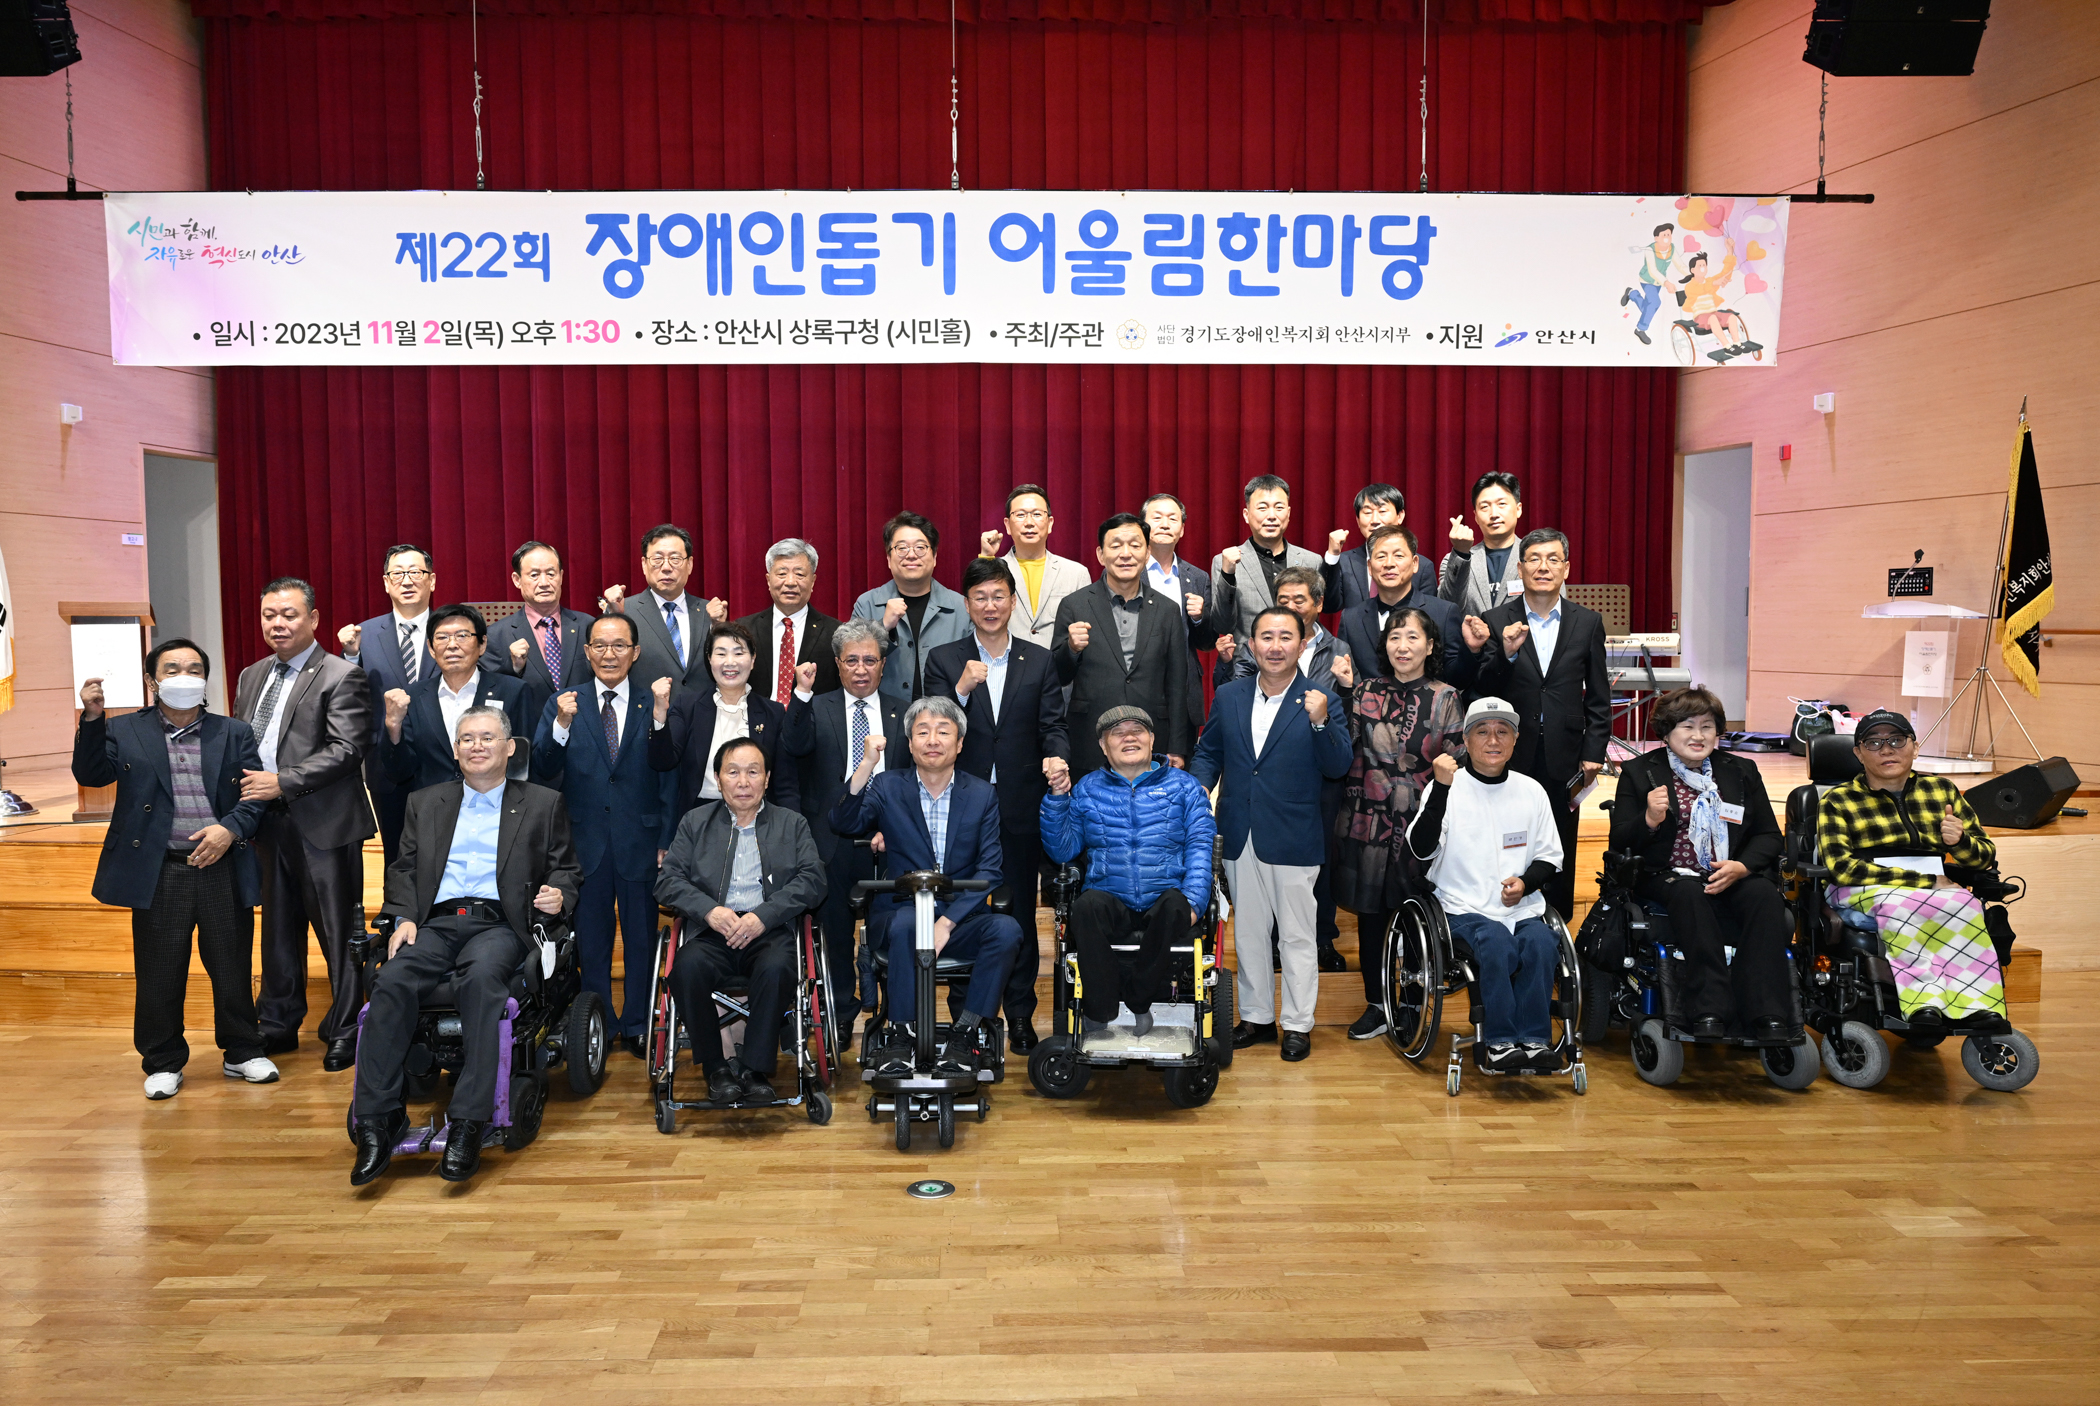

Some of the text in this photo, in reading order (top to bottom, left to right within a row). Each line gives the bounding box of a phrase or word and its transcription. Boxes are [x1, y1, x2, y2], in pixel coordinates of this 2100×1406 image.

[127, 215, 180, 247] 시민과
[144, 244, 306, 271] 자유로운 혁신도시 안산
[395, 209, 1438, 301] 제22회 장애인돕기 어울림한마당
[274, 320, 362, 347] 2023년
[367, 319, 417, 347] 11월
[422, 319, 504, 350] 2일(목)
[510, 319, 557, 347] 오후
[560, 319, 621, 344] 1:30
[714, 318, 782, 346] 안산시
[788, 318, 879, 346] 상록구청
[886, 317, 971, 349] (시민홀)
[1004, 321, 1105, 349] 주최/주관
[1157, 324, 1176, 334] 사단
[1157, 335, 1175, 345] 법인
[1181, 325, 1412, 344] 경기도장애인복지회 안산시지부
[1439, 323, 1483, 350] 지원
[1535, 329, 1597, 345] 안산시
[1645, 635, 1671, 643] KROSS
